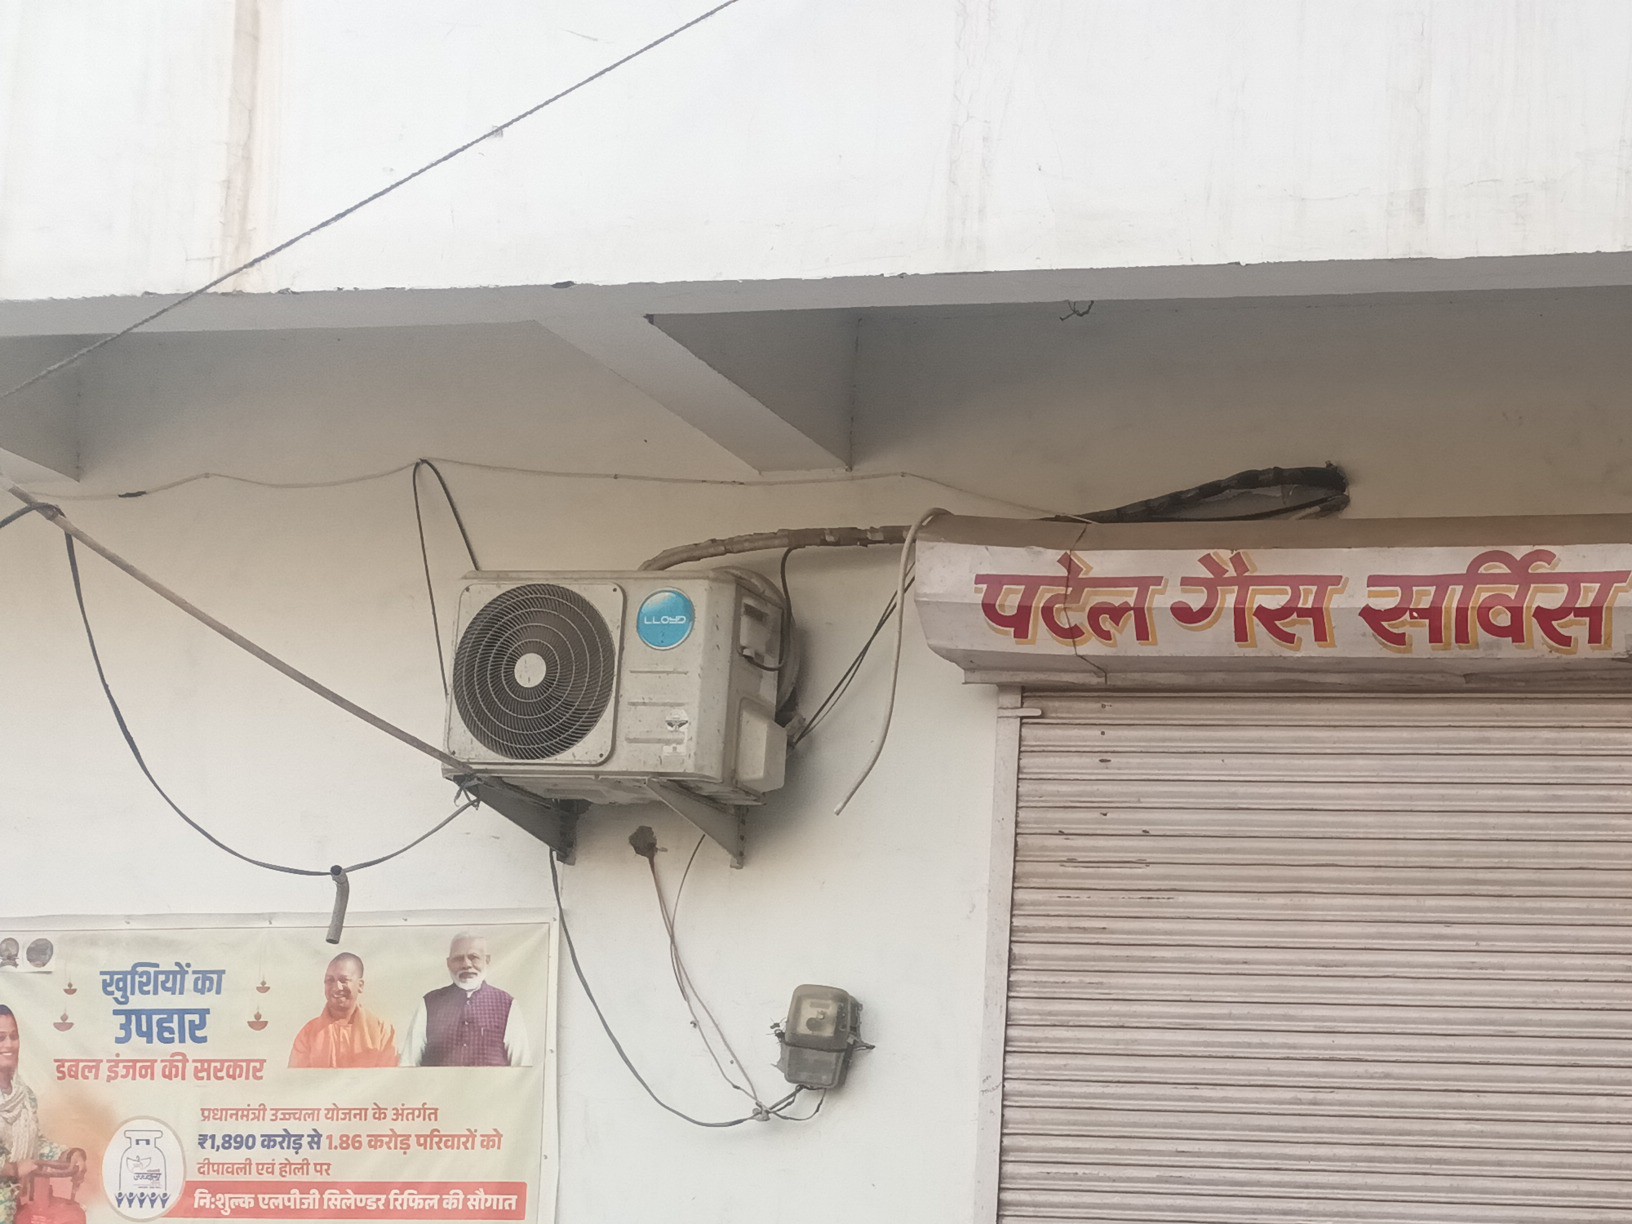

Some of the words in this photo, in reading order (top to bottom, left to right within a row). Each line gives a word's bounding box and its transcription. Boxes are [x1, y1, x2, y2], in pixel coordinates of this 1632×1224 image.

[973, 552, 1168, 647] पटेल
[1170, 550, 1347, 649] गैस
[643, 614, 687, 625] LLOYD
[100, 962, 192, 1005] खुशियों
[192, 969, 226, 995] का
[112, 1008, 211, 1044] उपहार
[54, 1058, 103, 1081] डबल
[106, 1053, 158, 1082] इंजन
[160, 1052, 190, 1081] की
[192, 1058, 267, 1082] सरकार
[200, 1103, 266, 1121] प्रधानमंत्री
[324, 1103, 368, 1121] योजना
[372, 1102, 387, 1120] के
[391, 1102, 438, 1121] अंतर्गत
[198, 1134, 255, 1151] ₹1,890
[260, 1128, 303, 1154] करोड़
[307, 1128, 321, 1149] से
[327, 1134, 362, 1150] 1.86
[367, 1128, 410, 1154] करोड़
[415, 1128, 476, 1150] परिवारों
[480, 1128, 501, 1149] को
[197, 1158, 251, 1175] दीपावली
[255, 1158, 275, 1175] एवं
[278, 1158, 310, 1177] होली
[313, 1162, 330, 1175] पर
[258, 1188, 319, 1208] एलपीजी
[323, 1188, 385, 1209] सिलेण्डर
[389, 1189, 439, 1209] रिफिल
[442, 1189, 463, 1209] की
[466, 1188, 516, 1209] सौगात
